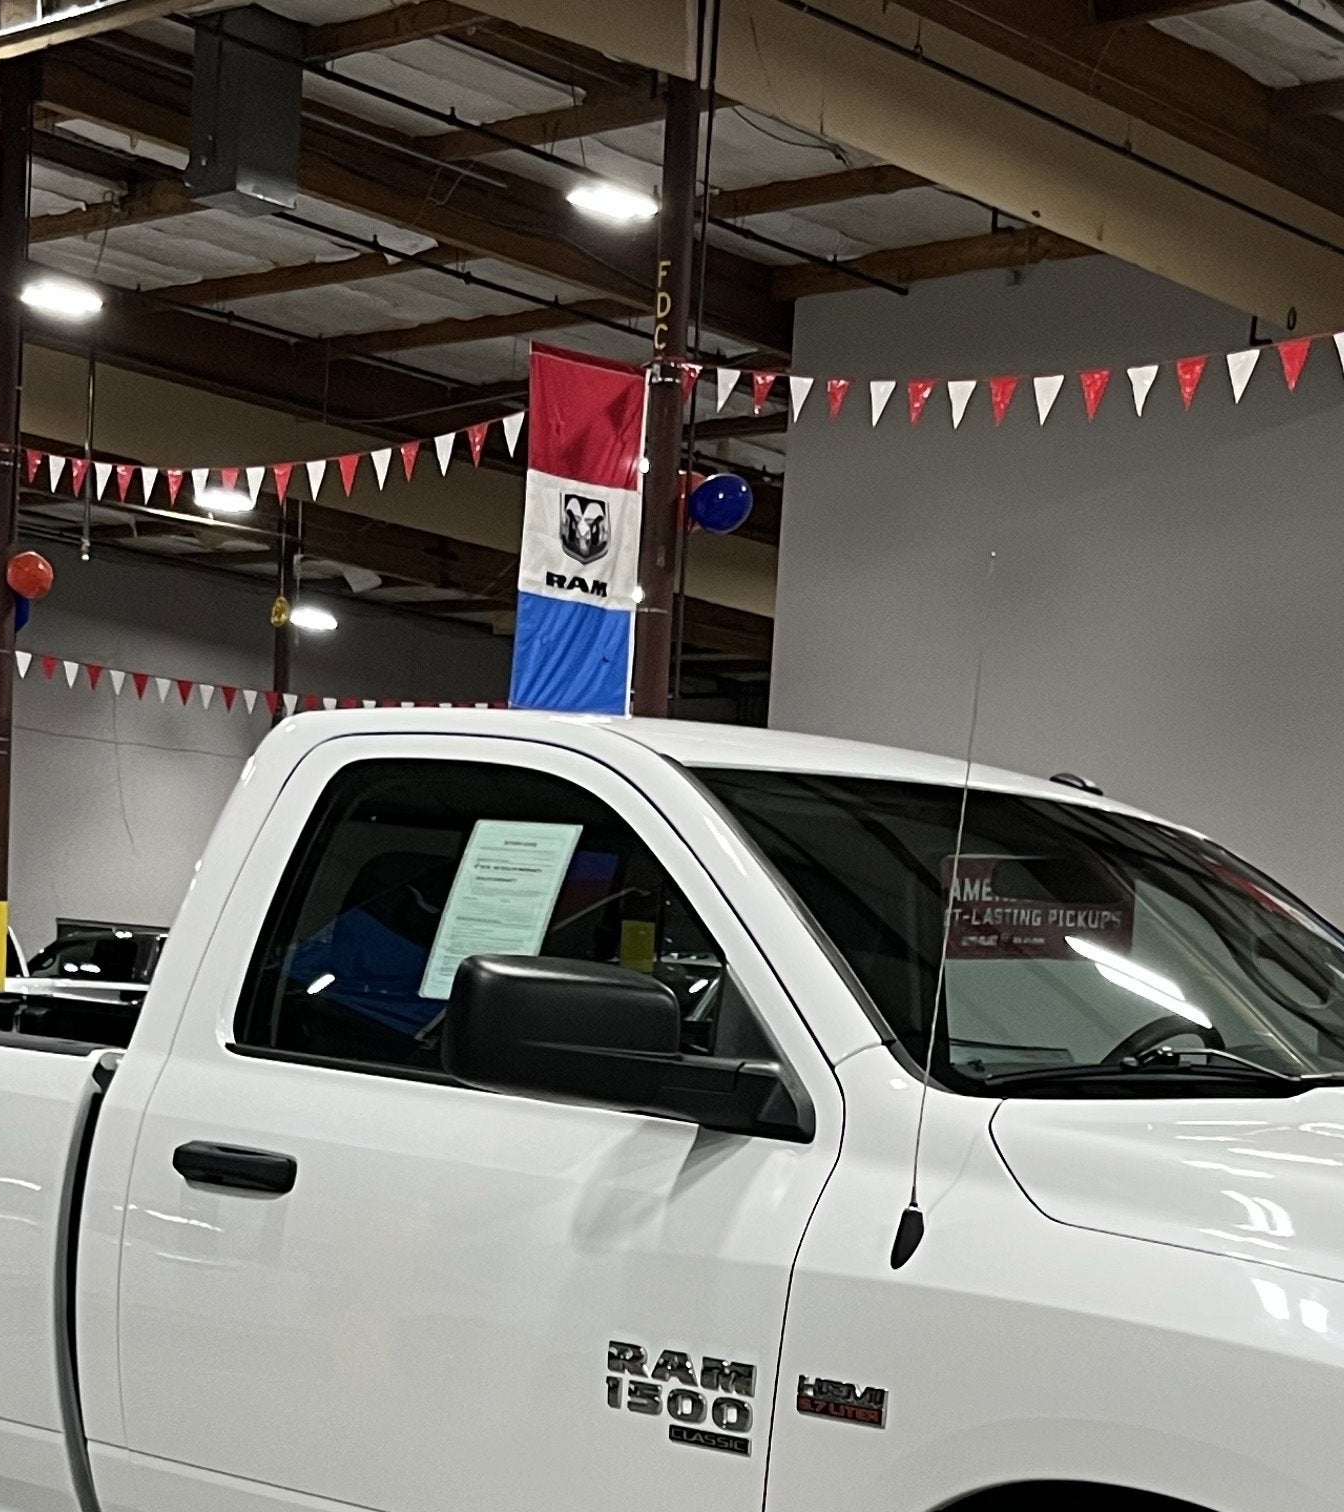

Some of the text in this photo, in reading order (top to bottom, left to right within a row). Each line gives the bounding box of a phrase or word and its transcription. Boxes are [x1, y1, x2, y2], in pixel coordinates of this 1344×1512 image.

[545, 570, 608, 598] RAM
[1047, 910, 1123, 929] PICKUPS
[607, 1339, 756, 1398] RAM
[606, 1375, 754, 1434] 1500
[828, 1402, 880, 1422] LITER
[670, 1426, 750, 1454] CLASSIC
